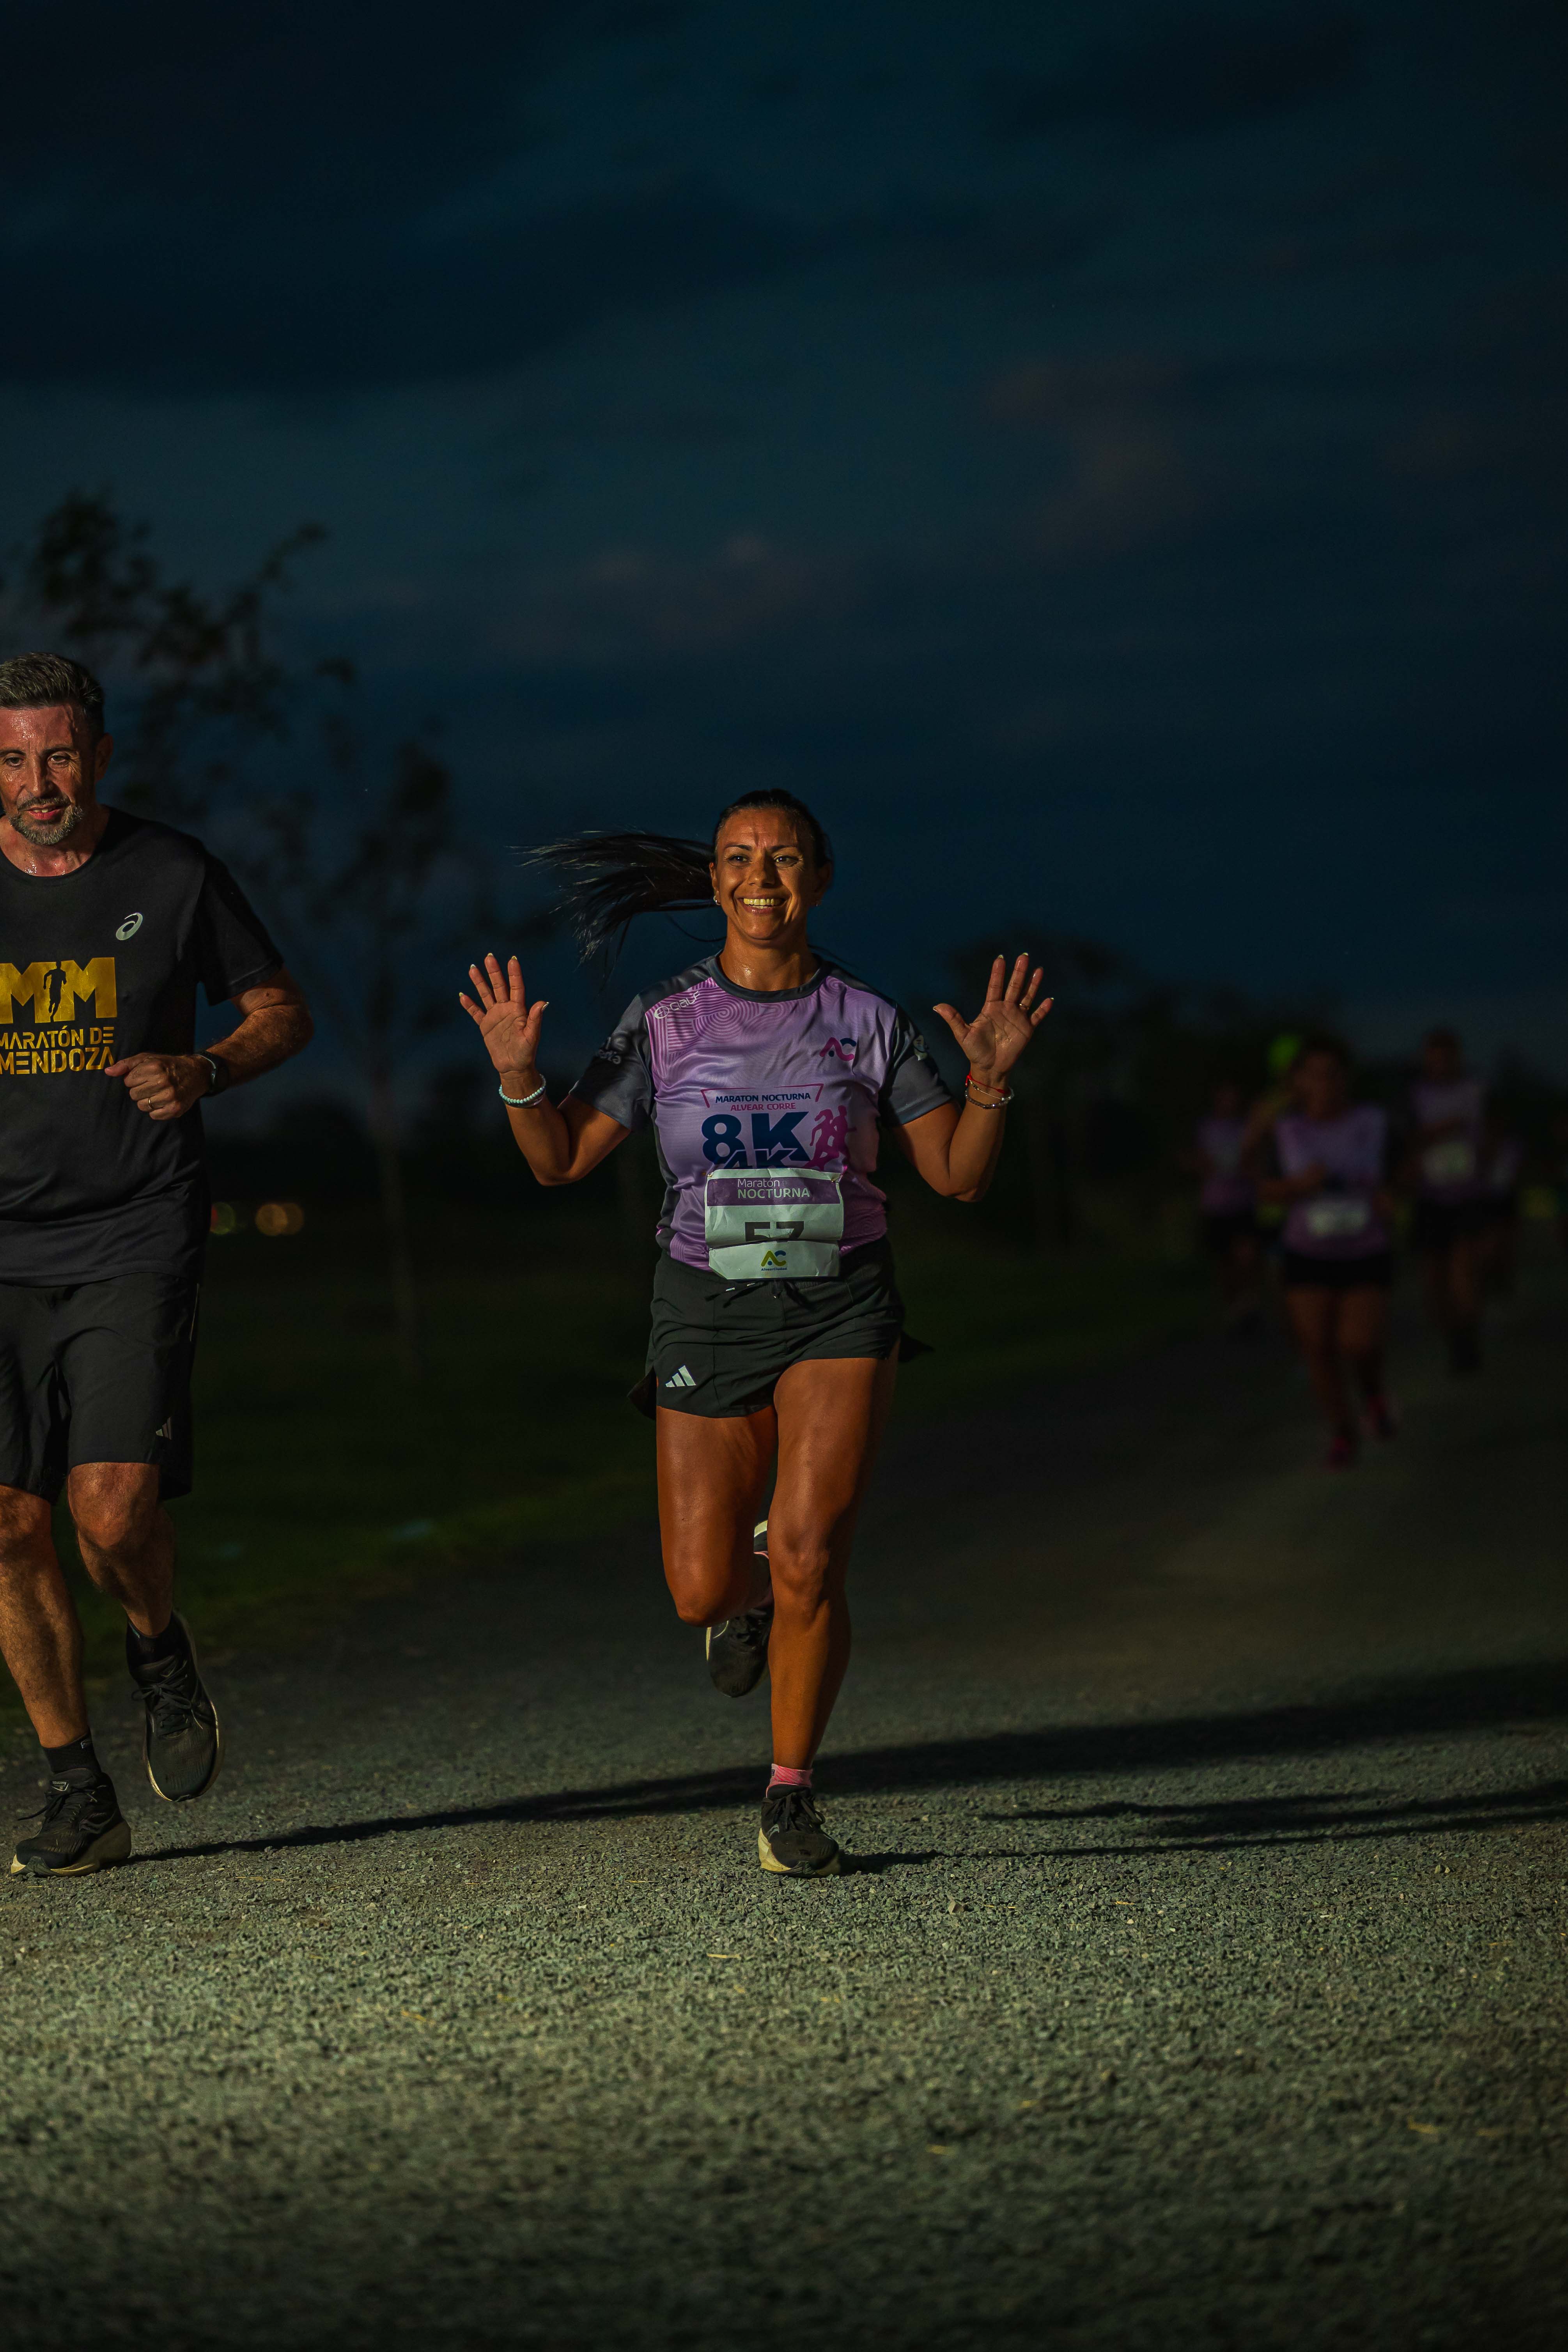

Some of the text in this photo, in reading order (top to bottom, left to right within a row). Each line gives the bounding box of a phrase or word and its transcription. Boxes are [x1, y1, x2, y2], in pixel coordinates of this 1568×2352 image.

[89, 1026, 114, 1045] DE
[0, 1046, 115, 1075] MENDOZA
[716, 1093, 811, 1103] MARATON NOCTURNA
[737, 1178, 780, 1187] Maratón
[737, 1188, 810, 1199] NOCTURNA
